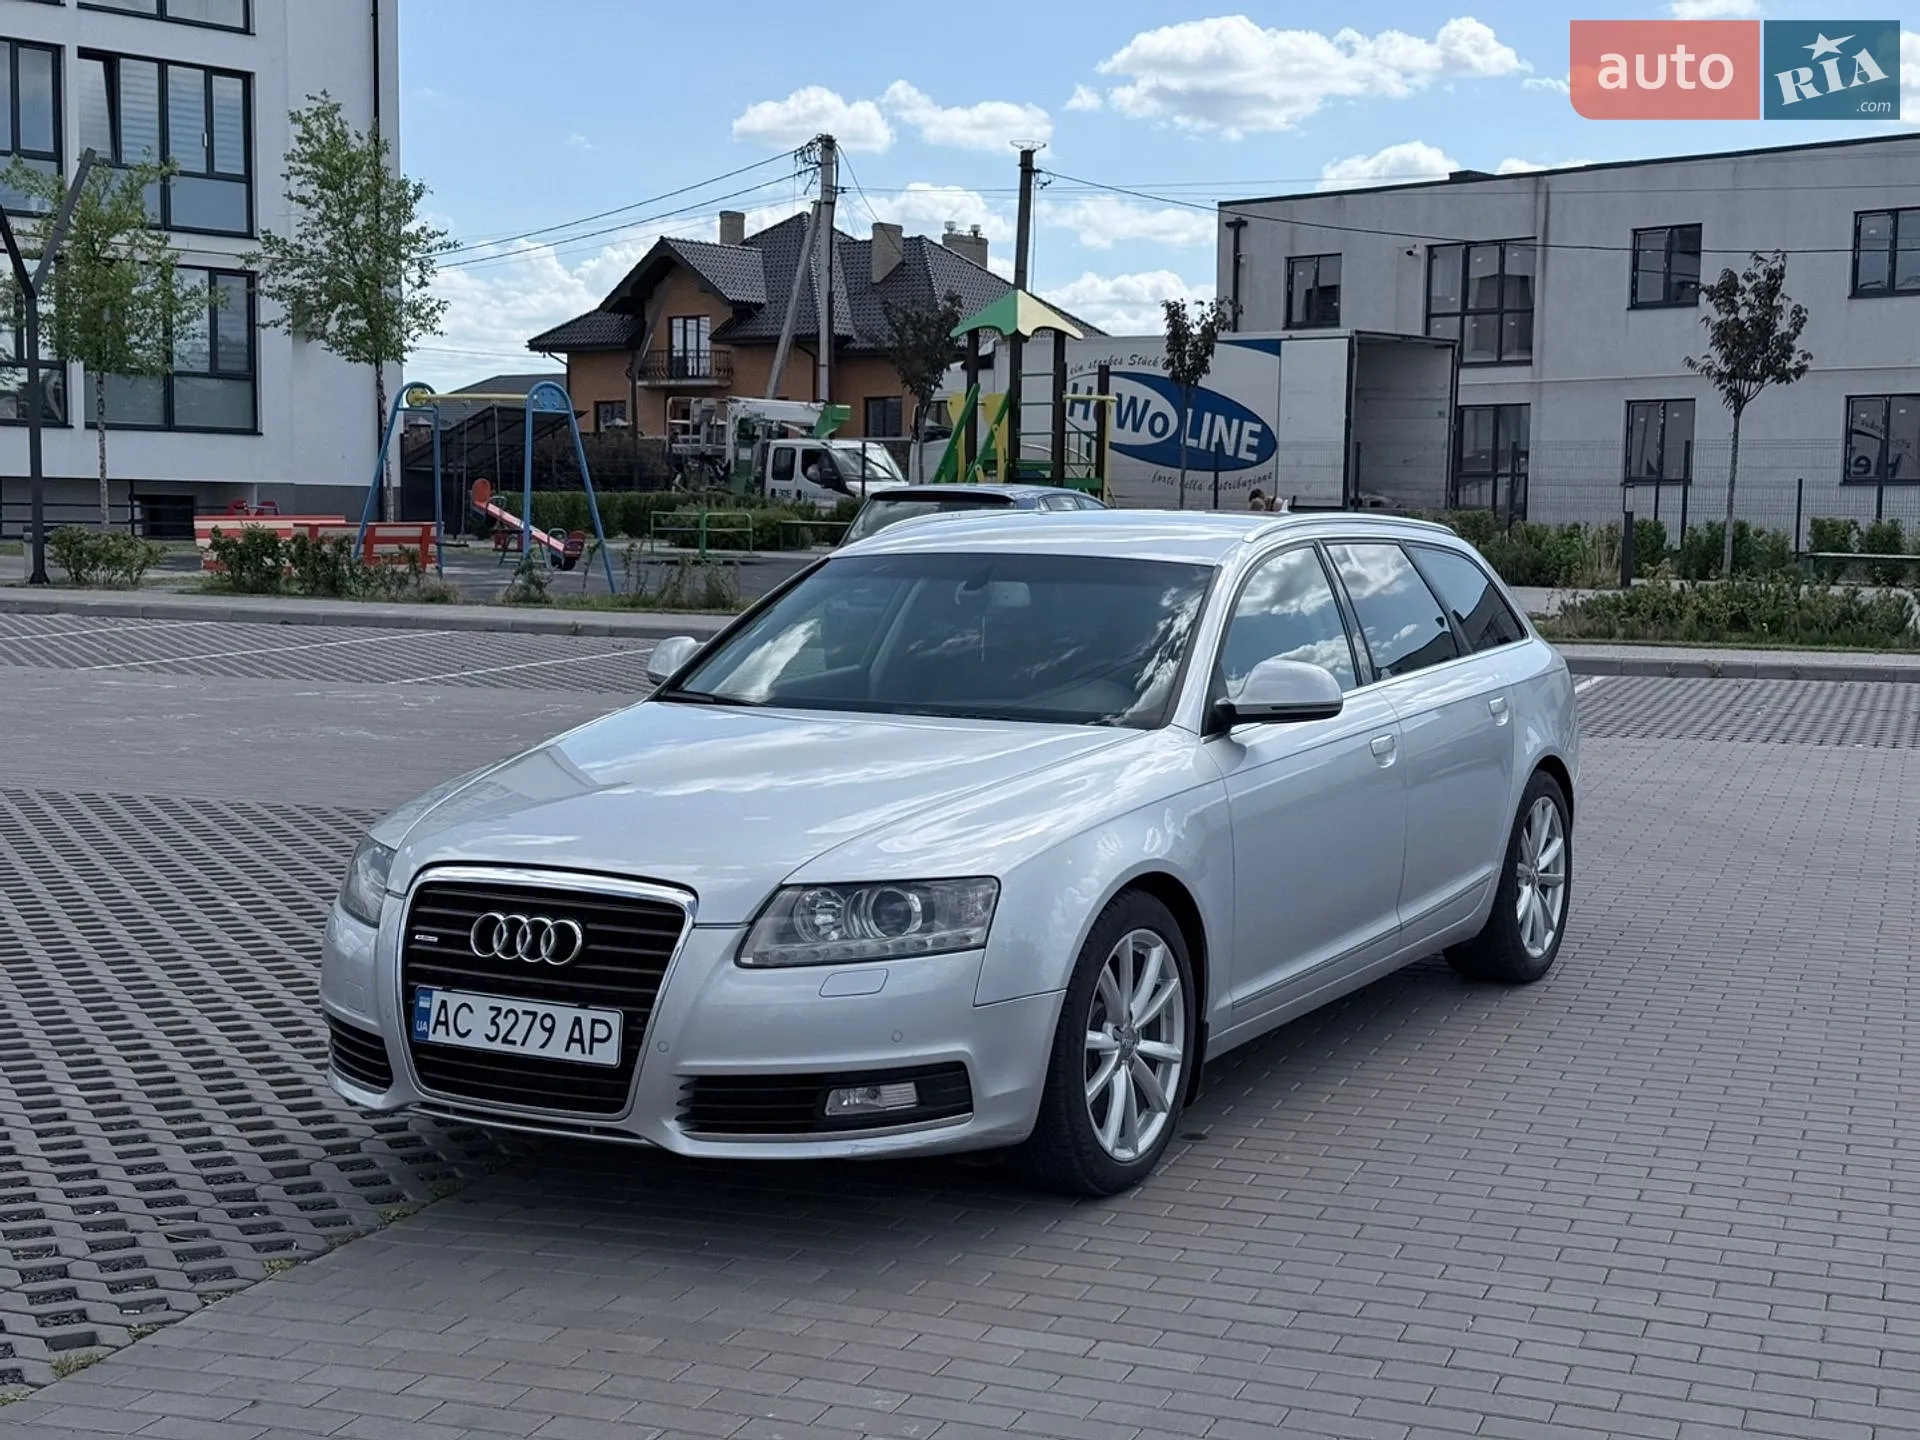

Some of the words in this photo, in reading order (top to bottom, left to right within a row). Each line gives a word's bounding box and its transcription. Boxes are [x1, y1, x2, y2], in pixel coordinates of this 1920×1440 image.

[1067, 382, 1171, 438] HWo
[1181, 408, 1262, 462] LINE
[416, 1020, 428, 1032] UA
[431, 999, 475, 1039] AC
[484, 1005, 557, 1050] 3279
[564, 1015, 613, 1056] AP
